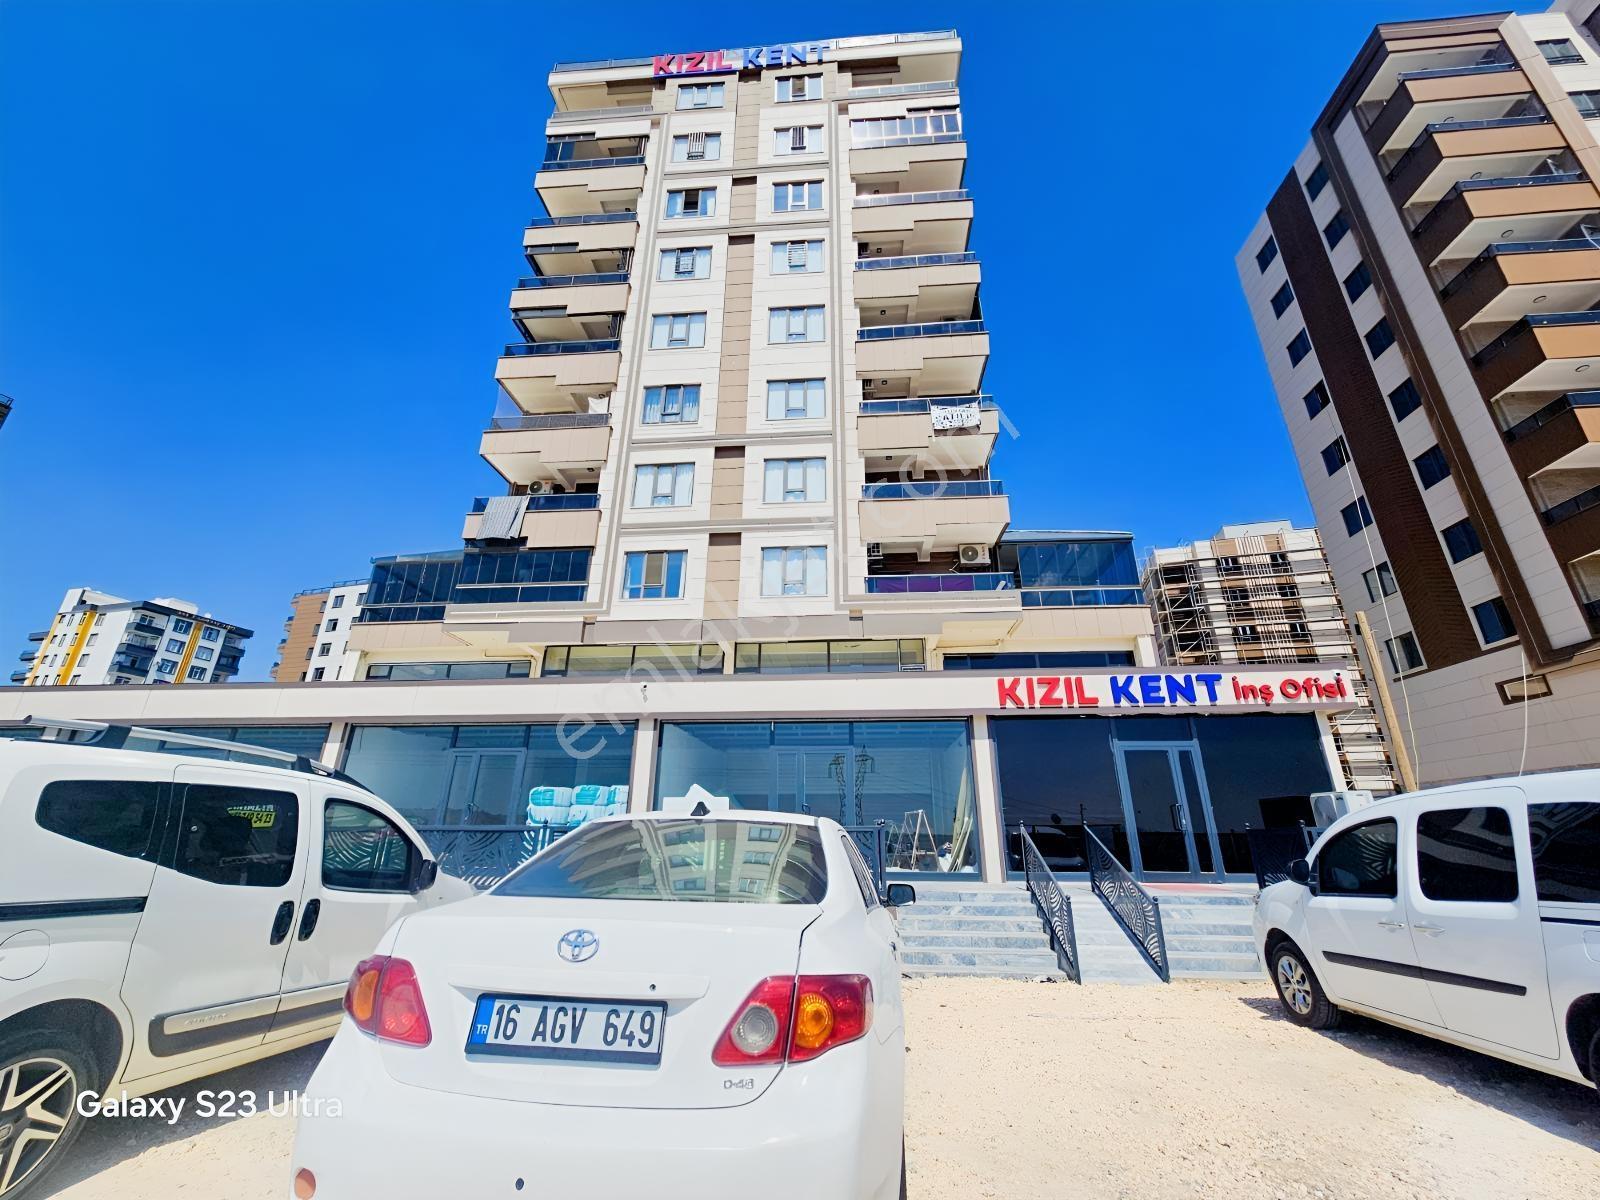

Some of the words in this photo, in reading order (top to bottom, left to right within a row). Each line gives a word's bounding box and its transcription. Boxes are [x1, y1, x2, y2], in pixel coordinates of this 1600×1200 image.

[653, 50, 733, 76] KIZIL
[743, 44, 831, 69] KENT
[998, 676, 1099, 708] KIZIL
[1110, 673, 1222, 707] KENT
[1280, 672, 1347, 699] Ofisi
[476, 1024, 488, 1035] TR
[494, 1004, 521, 1041] 16
[532, 1006, 587, 1044] AGV
[602, 1008, 655, 1048] 649
